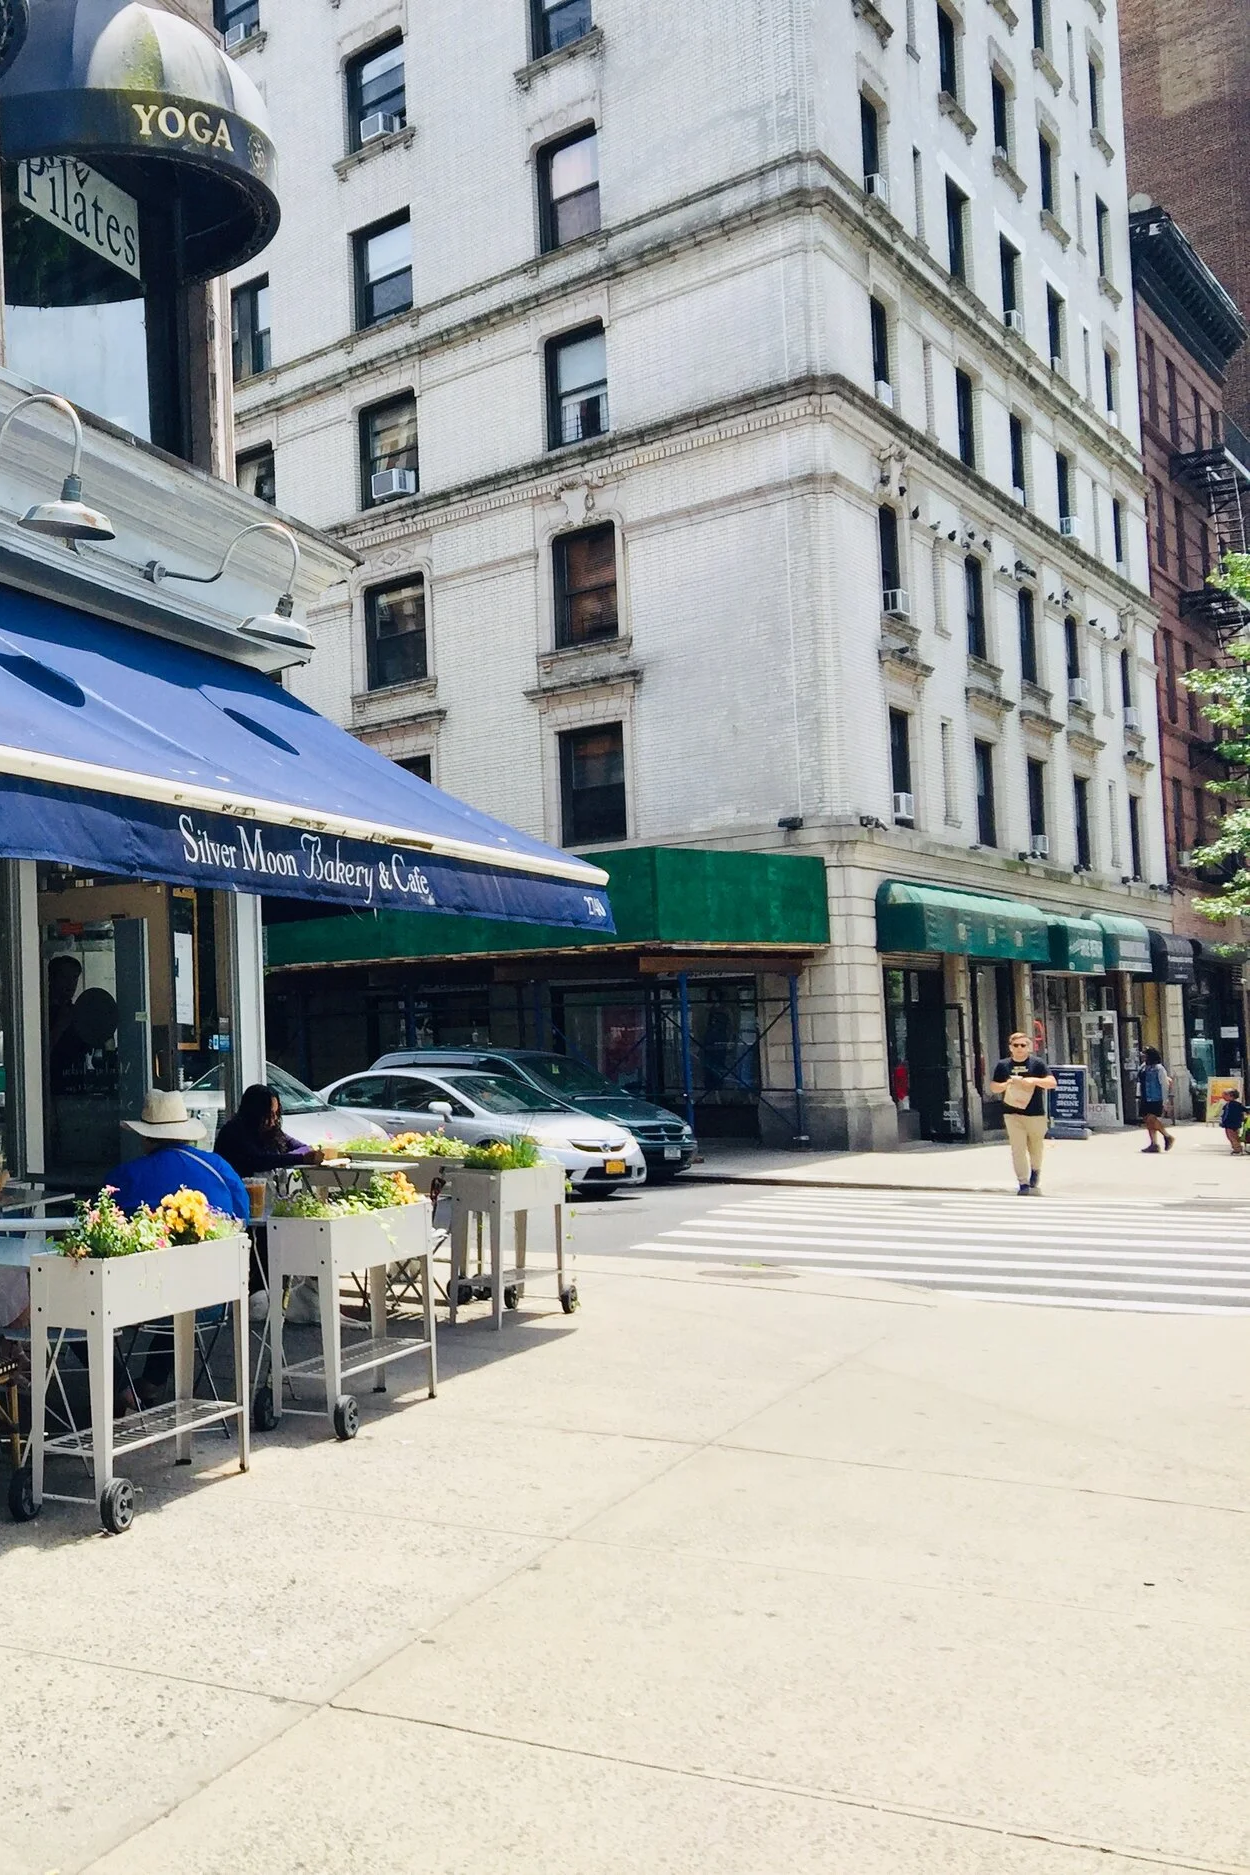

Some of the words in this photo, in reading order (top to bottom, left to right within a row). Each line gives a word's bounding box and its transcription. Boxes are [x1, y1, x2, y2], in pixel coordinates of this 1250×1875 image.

[132, 104, 235, 152] YOGA
[24, 158, 136, 267] Pilates
[178, 814, 237, 869] Silver
[236, 825, 299, 877] Moon
[301, 833, 374, 904] Bakery
[378, 861, 393, 890] &
[391, 853, 430, 895] Cafe
